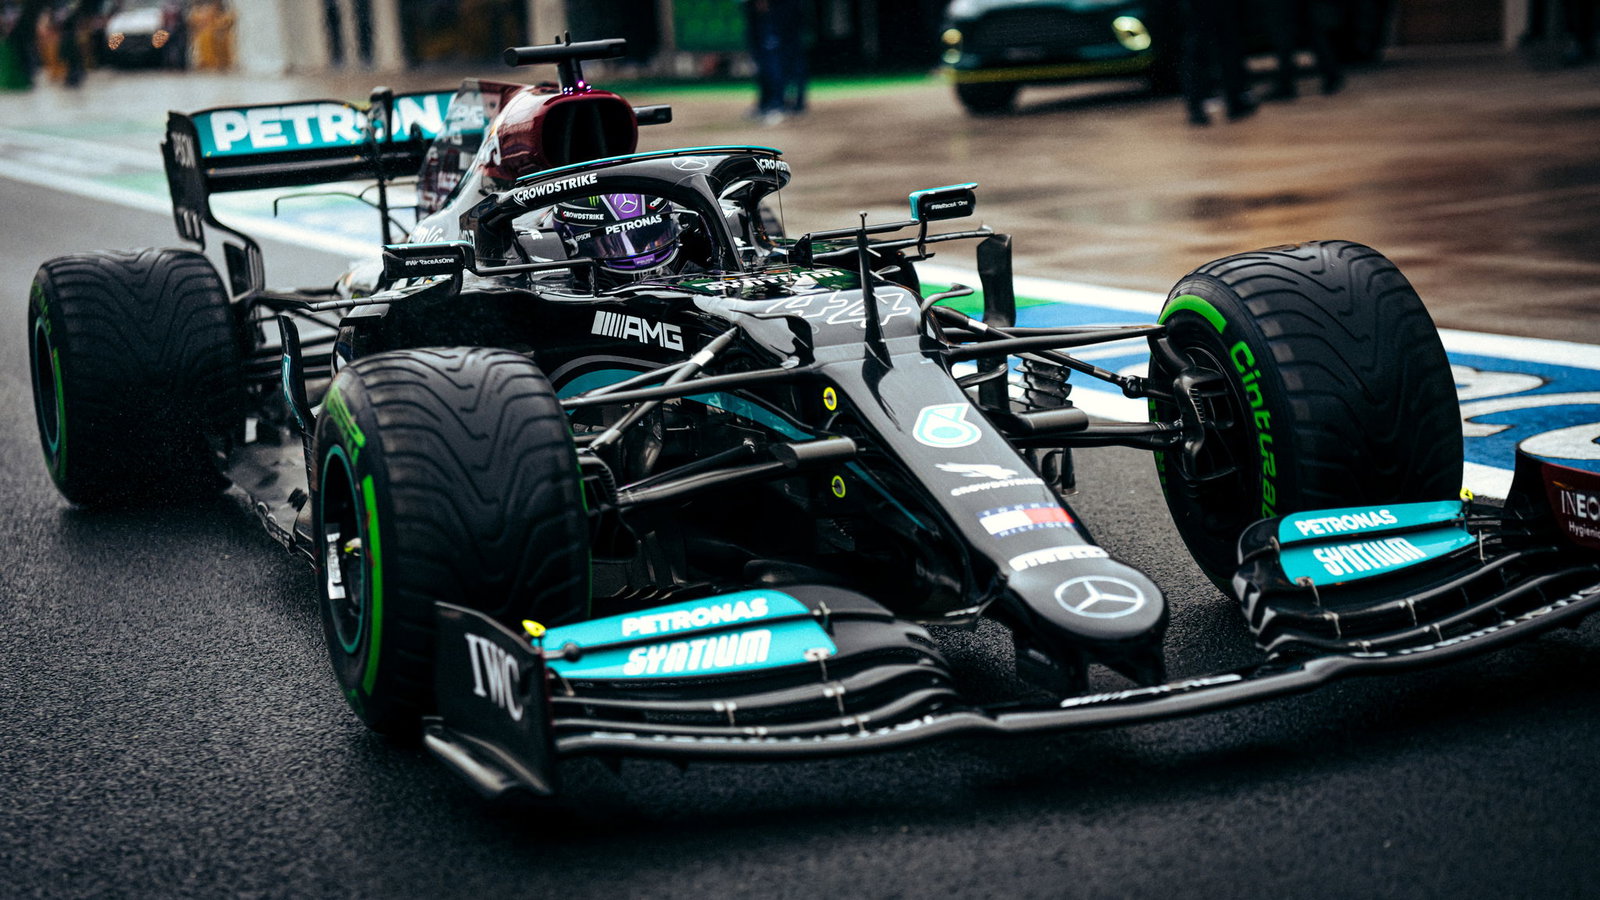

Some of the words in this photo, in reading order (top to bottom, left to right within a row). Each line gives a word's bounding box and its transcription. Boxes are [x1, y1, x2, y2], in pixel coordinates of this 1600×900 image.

[517, 173, 598, 201] CROWDSTRIKE
[563, 211, 604, 220] CROWDSTRIKE
[605, 214, 662, 235] PETRONAS
[622, 315, 684, 353] AMG
[1230, 340, 1277, 518] Cintura
[1295, 509, 1398, 536] PETRONAS
[1313, 537, 1427, 576] SYNTIUM
[622, 598, 769, 637] PETRONAS
[623, 629, 772, 676] SYNTIUM
[464, 632, 524, 722] IWC
